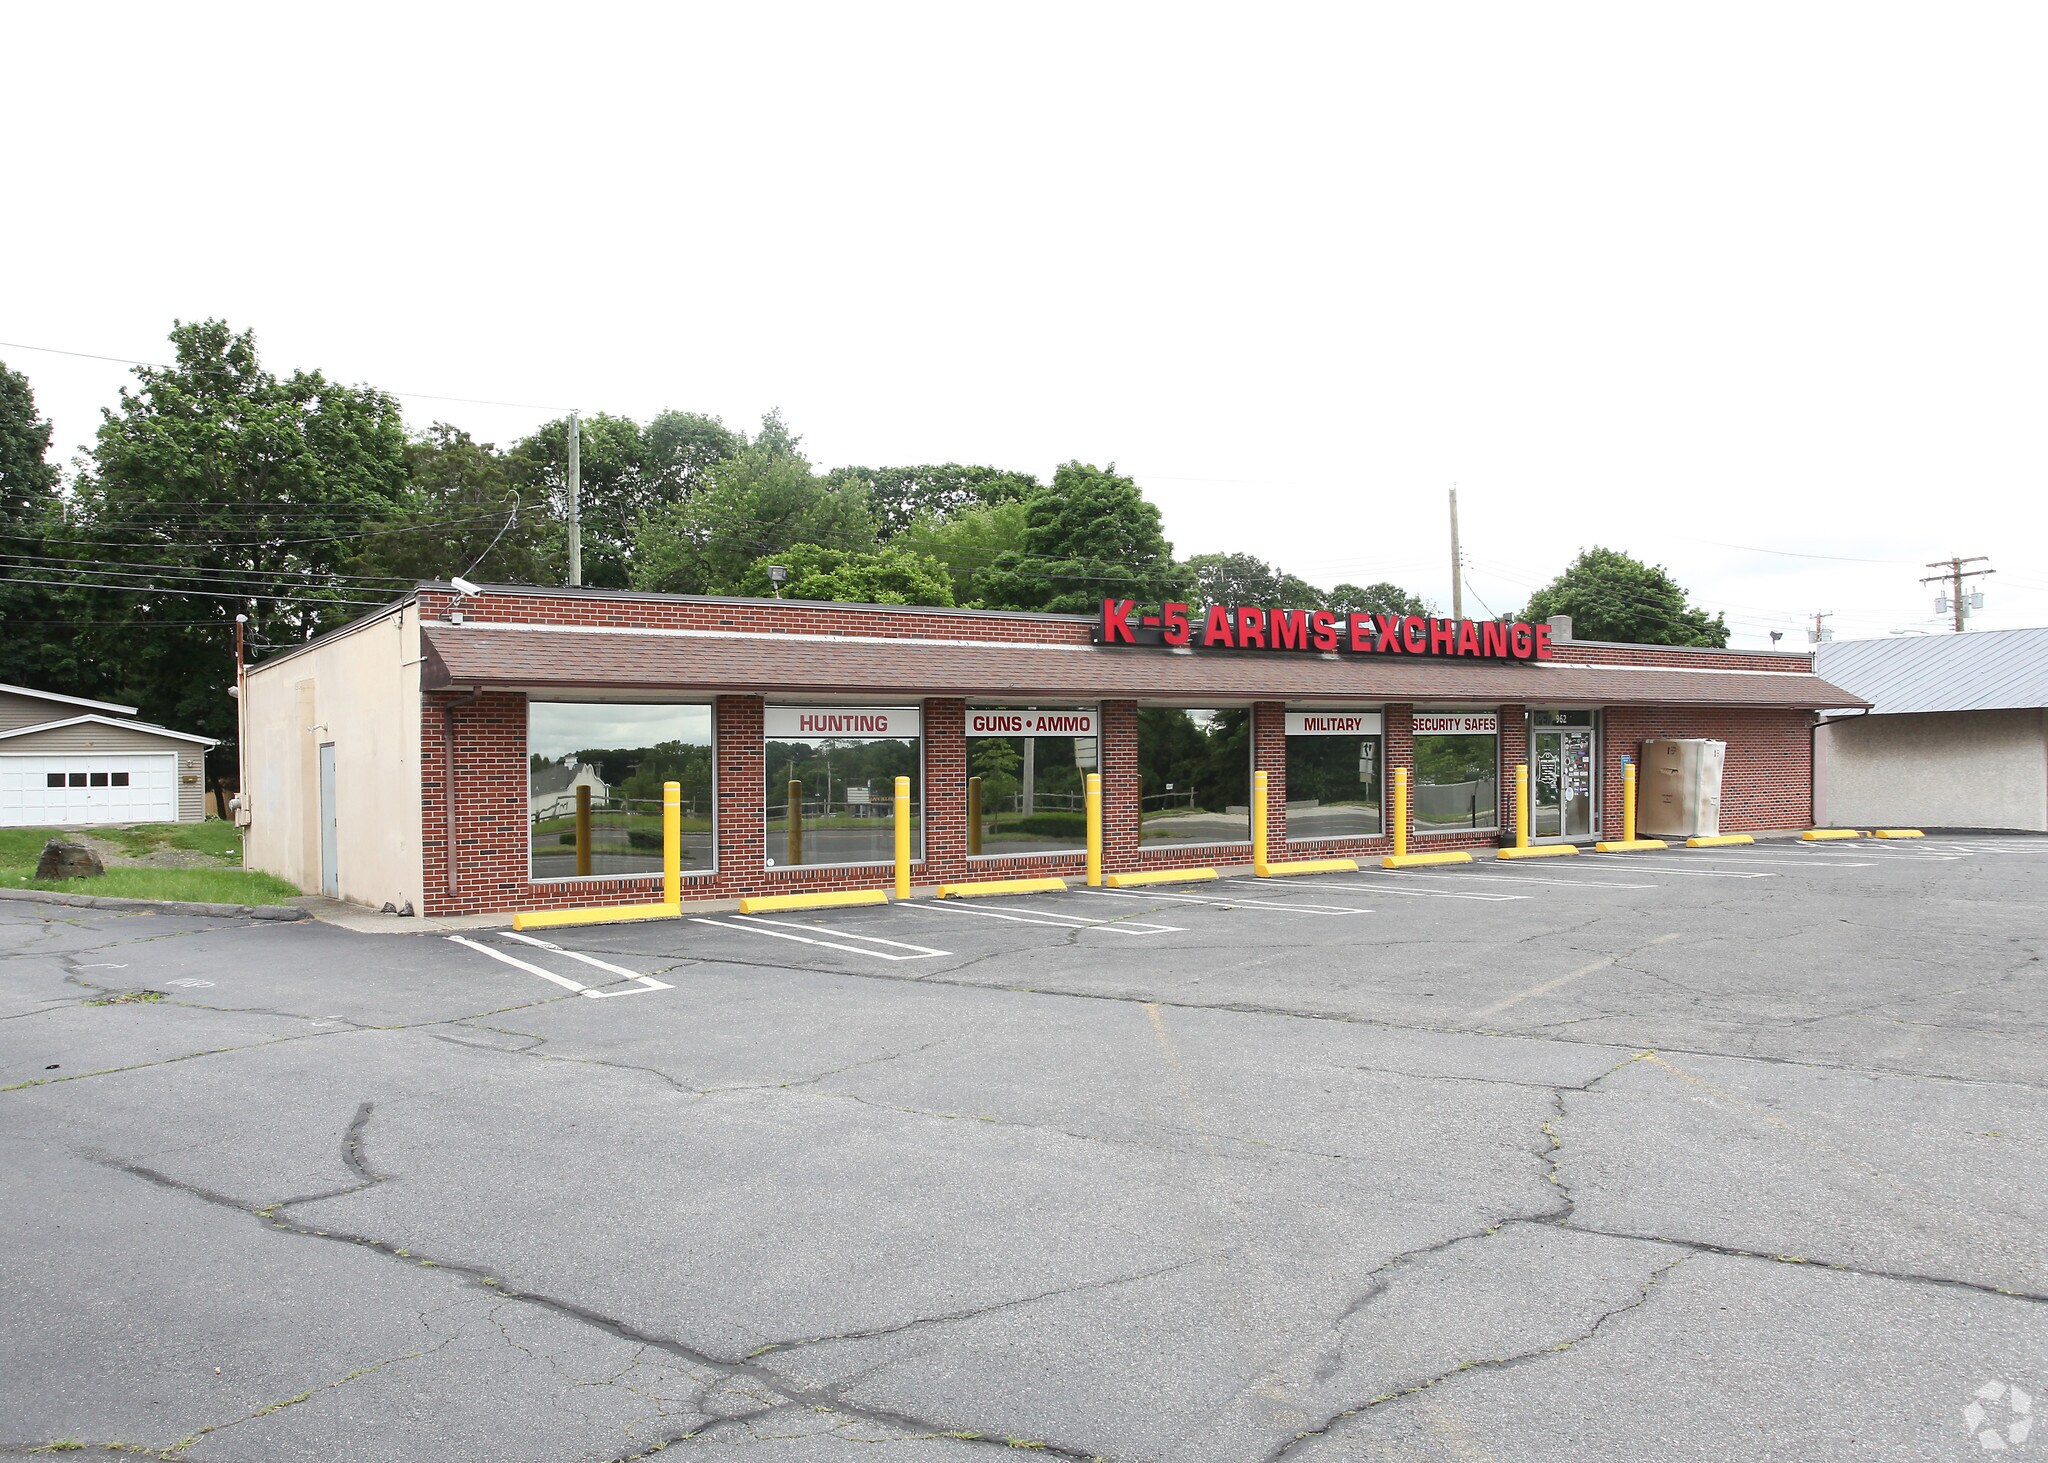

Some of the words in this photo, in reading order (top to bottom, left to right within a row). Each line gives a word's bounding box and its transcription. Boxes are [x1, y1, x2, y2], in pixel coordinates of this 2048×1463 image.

[1103, 598, 1189, 645] K-5
[1203, 606, 1337, 651] ARMS
[1350, 612, 1553, 659] EXCHANGE
[800, 715, 888, 732] HUNTING
[973, 716, 1022, 732] GUNS
[1035, 716, 1090, 732] AMMO
[1304, 717, 1362, 731] MILITARY
[1412, 717, 1461, 731] SECURITY
[1464, 718, 1496, 731] SAFES
[1555, 714, 1567, 724] 962
